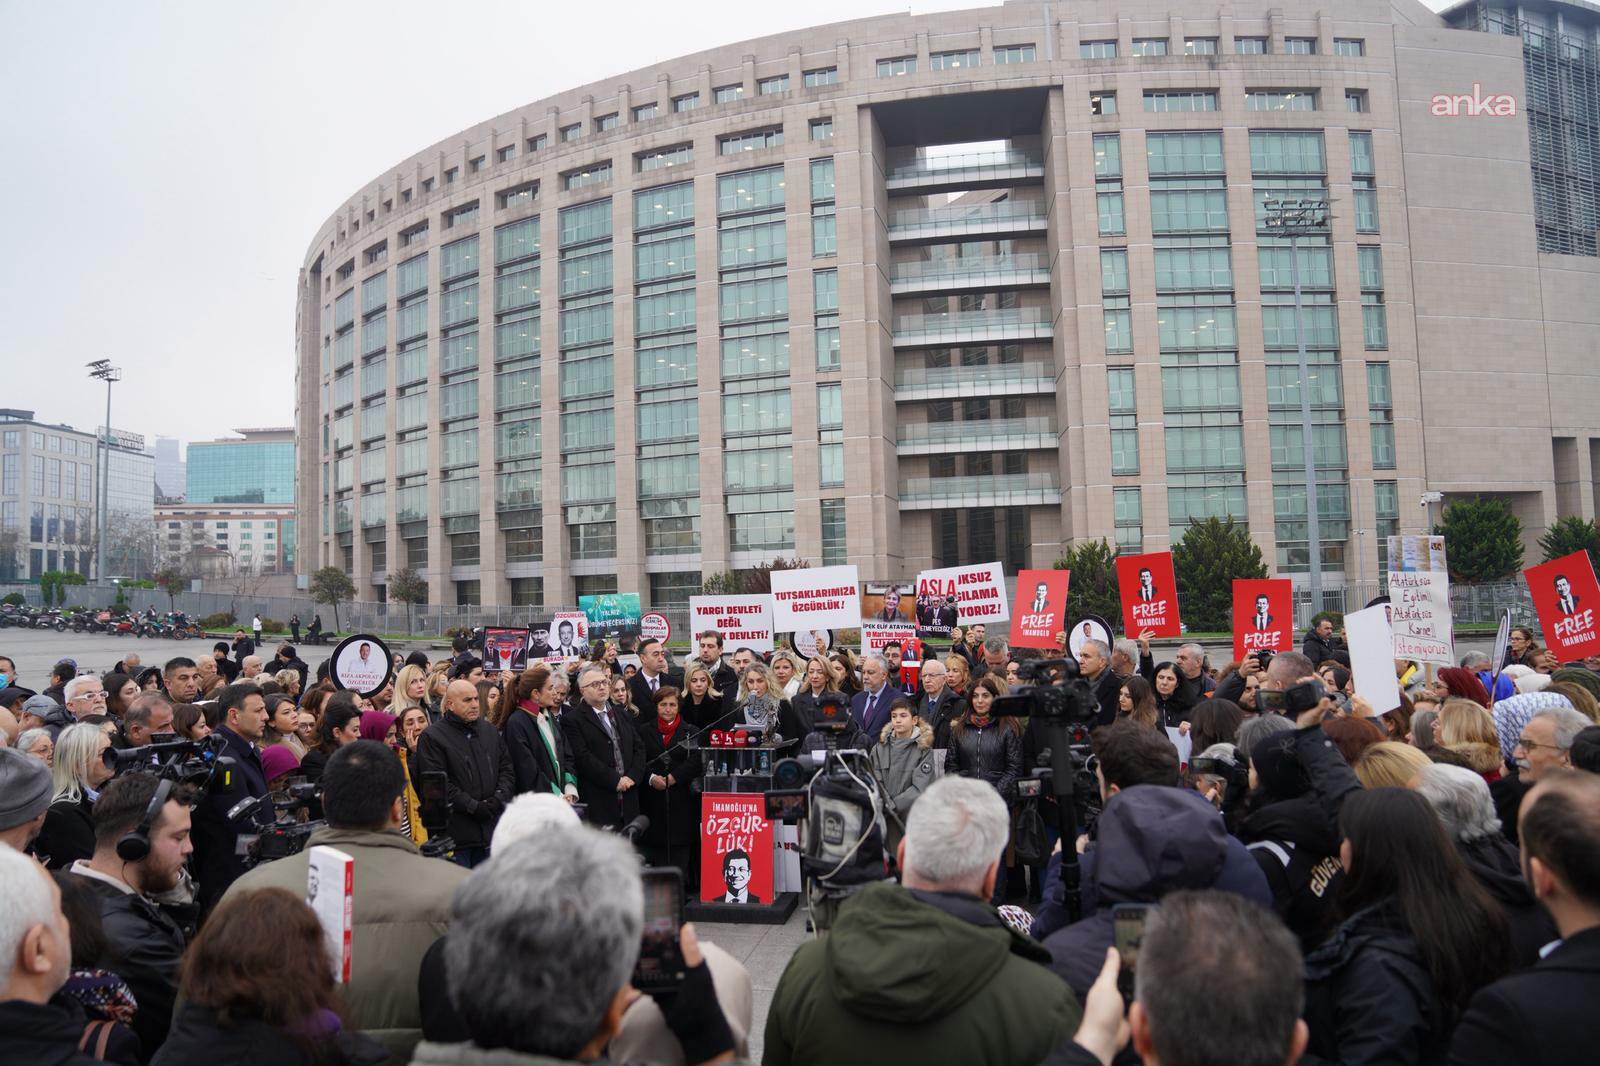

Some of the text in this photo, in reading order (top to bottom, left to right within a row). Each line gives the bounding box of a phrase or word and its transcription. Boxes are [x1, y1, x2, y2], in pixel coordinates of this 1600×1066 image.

[774, 586, 856, 601] TUTSAKLARIMIZA
[919, 578, 956, 597] ASLA
[696, 604, 762, 615] YARGI DEVLETİ
[1132, 600, 1167, 619] FREE
[717, 616, 742, 628] DEĞİL
[1020, 613, 1055, 629] FREE
[1554, 608, 1594, 640] FREE
[1244, 631, 1281, 649] FREE
[1562, 630, 1596, 647] IMAMOGLU
[712, 801, 758, 812] İMAMOĞLU'NA
[706, 812, 769, 836] ÖZGÜR-
[716, 833, 754, 854] LÜK!
